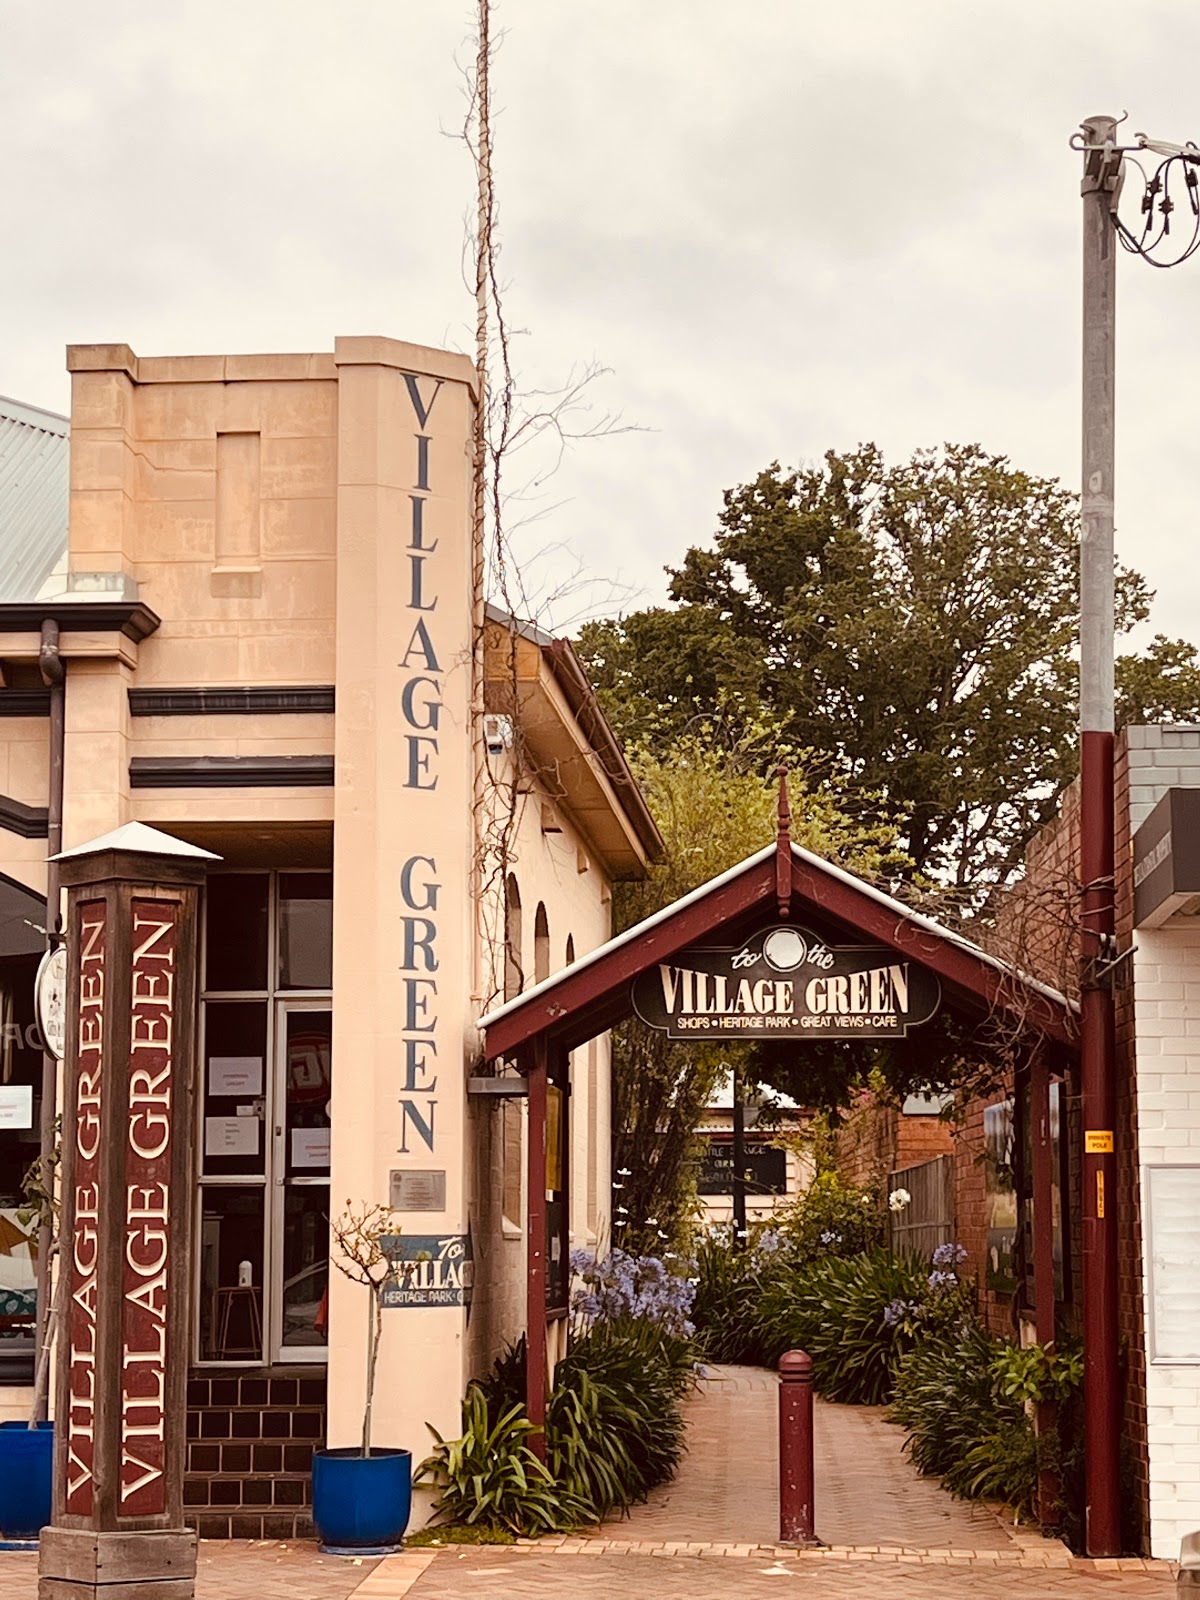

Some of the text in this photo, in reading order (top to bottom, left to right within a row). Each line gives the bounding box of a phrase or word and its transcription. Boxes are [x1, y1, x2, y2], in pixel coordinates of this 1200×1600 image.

[397, 372, 445, 792] VILLAGE
[730, 943, 835, 970] to the
[396, 854, 442, 1154] GREEN
[659, 962, 909, 1015] VILLAGE GREEN
[677, 1015, 898, 1029] SHOPS HERITAGE PARK GREAT VIEWS CAFE
[66, 919, 105, 1500] VILLAGE GREEN
[120, 912, 174, 1503] VILLAGE GREEN
[437, 1236, 465, 1260] To
[384, 1291, 427, 1304] HERITAGE
[428, 1291, 454, 1303] PARK
